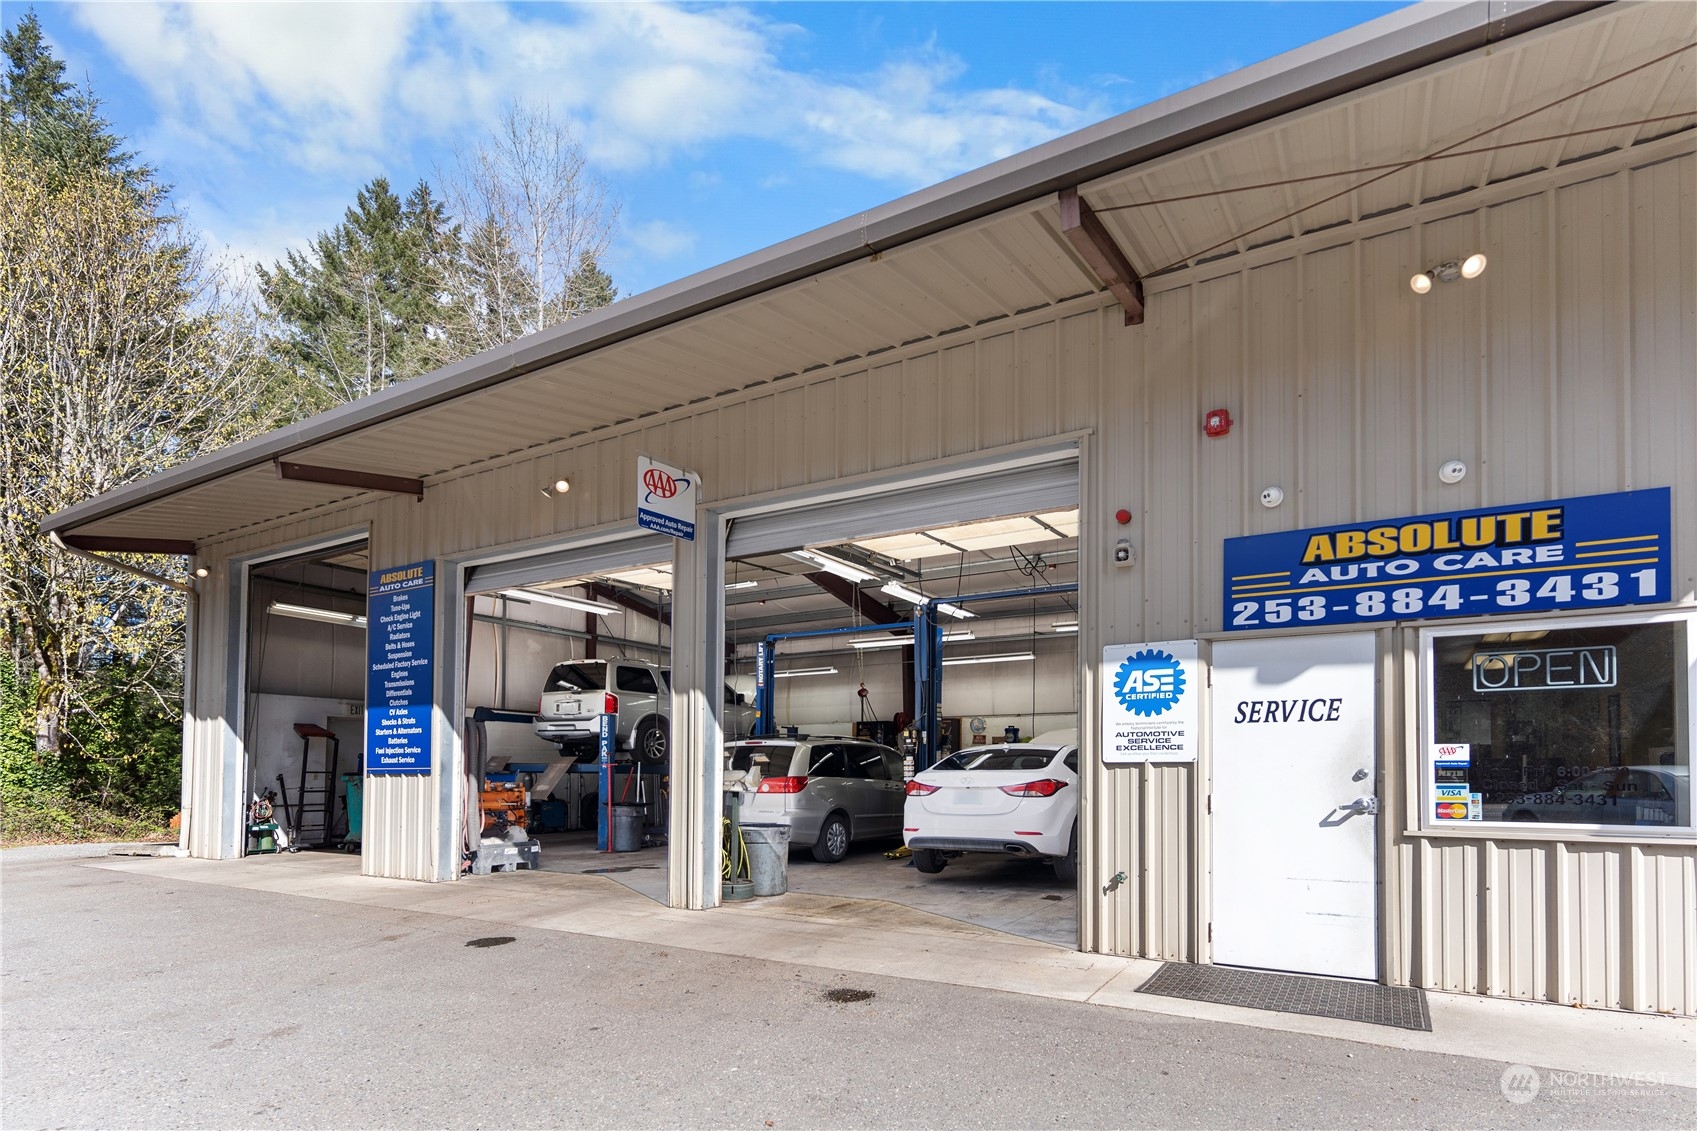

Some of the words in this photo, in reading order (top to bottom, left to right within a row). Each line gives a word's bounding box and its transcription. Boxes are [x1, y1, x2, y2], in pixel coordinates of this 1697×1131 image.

[646, 469, 676, 498] AAA
[640, 512, 664, 524] Approved
[665, 520, 677, 528] Auto
[678, 523, 693, 533] Repair
[1301, 507, 1562, 564] ABSOLUTE
[1299, 559, 1420, 584] AUTO
[1433, 544, 1564, 571] CARE
[380, 566, 423, 584] ABSOLUTE
[379, 583, 400, 592] AUTO
[402, 578, 423, 587] CARE
[1232, 568, 1656, 626] 253-884-3431
[390, 604, 410, 612] Tune-Ups
[394, 613, 409, 621] Engine
[410, 610, 421, 619] Light
[387, 624, 396, 632] A/C
[388, 651, 412, 659] Suspension
[373, 662, 394, 670] Scheduled
[1480, 650, 1609, 687] OPEN
[384, 680, 414, 688] Transmissions
[1122, 668, 1174, 693] ASE
[386, 689, 412, 697] Differentials
[350, 705, 364, 715] EXIT
[1234, 698, 1342, 724] SERVICE
[386, 747, 404, 755] Injection
[1604, 780, 1638, 791] Sun
[1496, 794, 1617, 806] 253-884-3431
